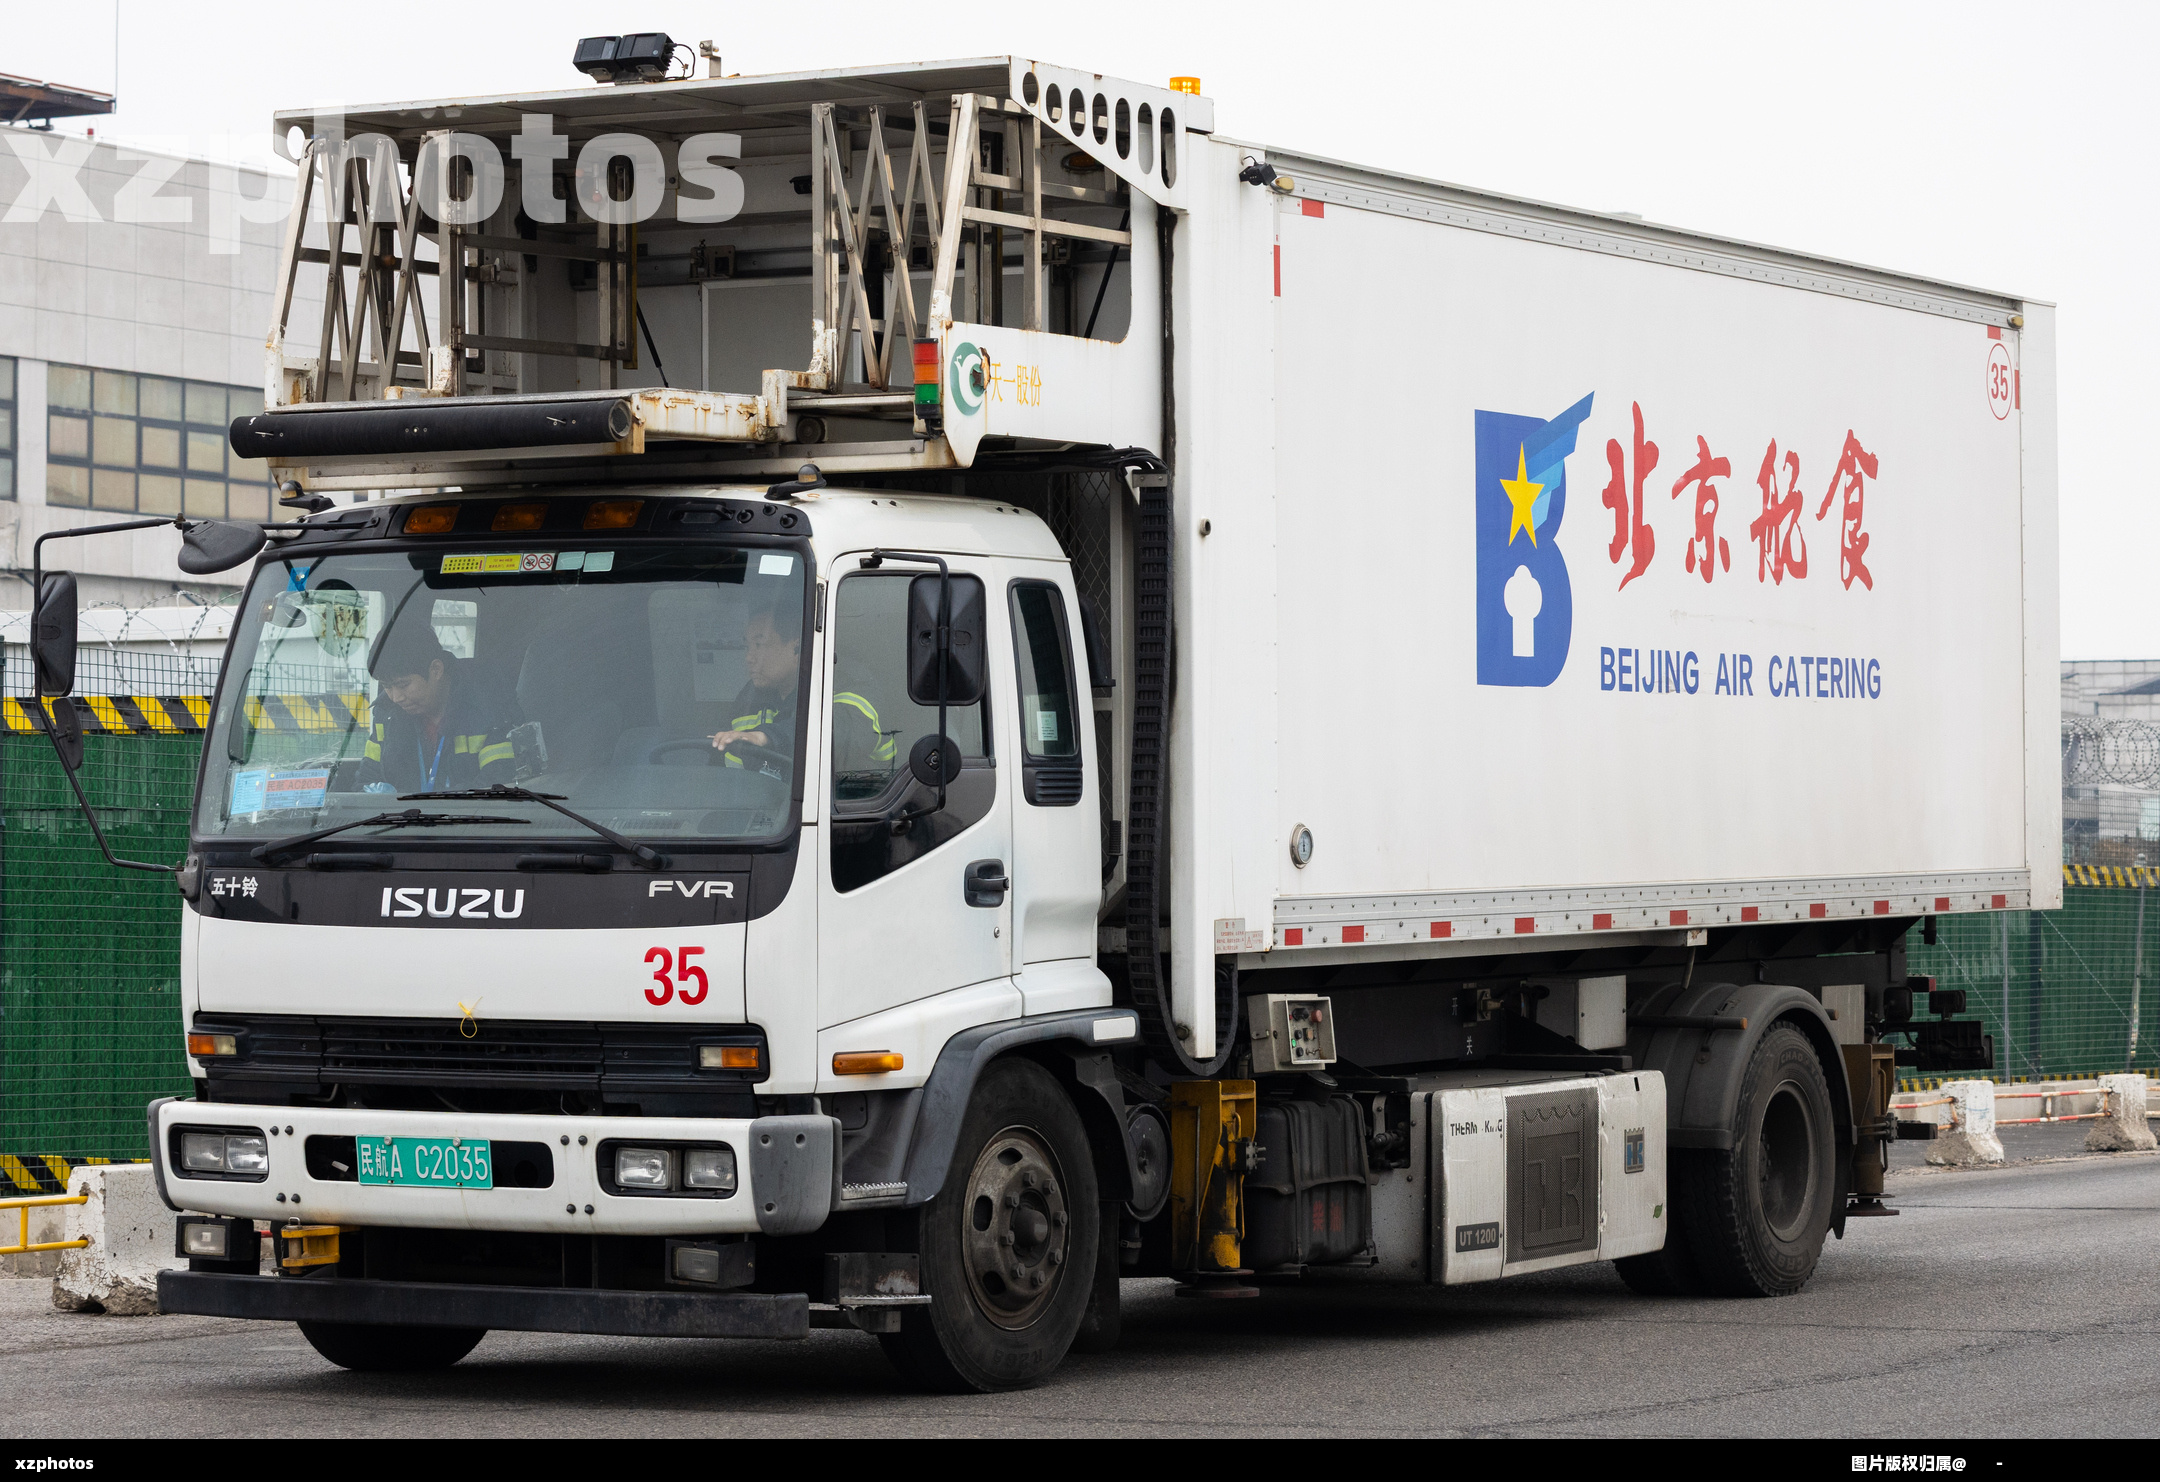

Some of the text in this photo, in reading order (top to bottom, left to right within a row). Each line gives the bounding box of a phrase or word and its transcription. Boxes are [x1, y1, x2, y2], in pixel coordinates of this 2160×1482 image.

[991, 362, 1042, 407] 天一股份
[1991, 362, 2008, 401] 35
[1602, 400, 1878, 592] 北京航食
[1600, 646, 1880, 699] BEIJING AIR CATERING
[211, 876, 258, 898] 五十铃
[380, 887, 525, 919] ISUZU
[648, 880, 734, 899] FVR
[643, 946, 709, 1006] 35
[1450, 1119, 1503, 1136] THERM KG
[361, 1143, 488, 1180] 民航A C2035
[1459, 1228, 1496, 1247] UT 1200
